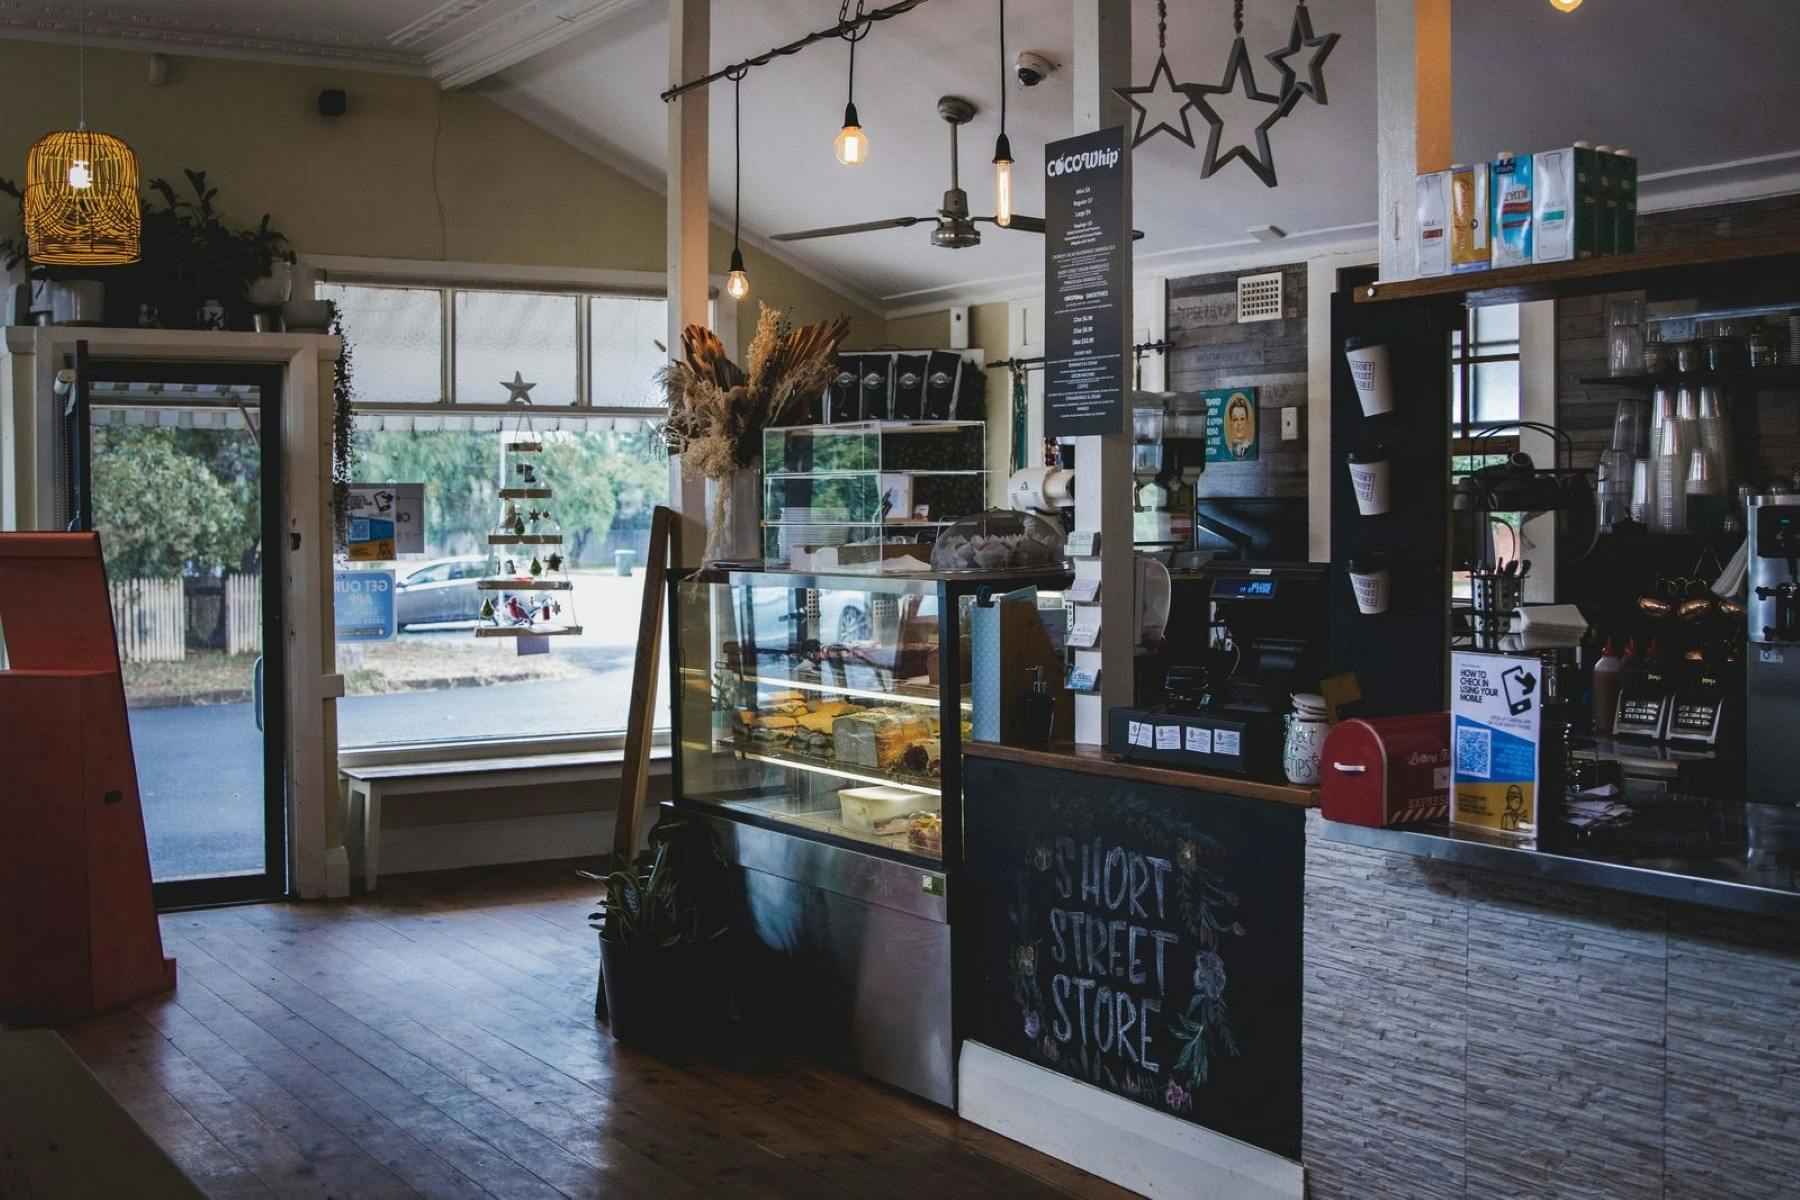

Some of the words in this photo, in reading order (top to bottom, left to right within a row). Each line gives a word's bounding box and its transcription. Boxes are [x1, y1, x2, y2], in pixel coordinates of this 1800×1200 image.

[1459, 669, 1478, 678] HOW
[1478, 671, 1487, 679] TO
[1459, 677, 1480, 687] CHECK
[1480, 679, 1489, 688] IN
[1459, 685, 1480, 695] USING
[1480, 687, 1499, 697] YOUR
[1459, 693, 1483, 704] MOBILE
[1055, 835, 1172, 920] SHORT
[1049, 907, 1179, 997] STREET
[1051, 973, 1163, 1074] STORE
